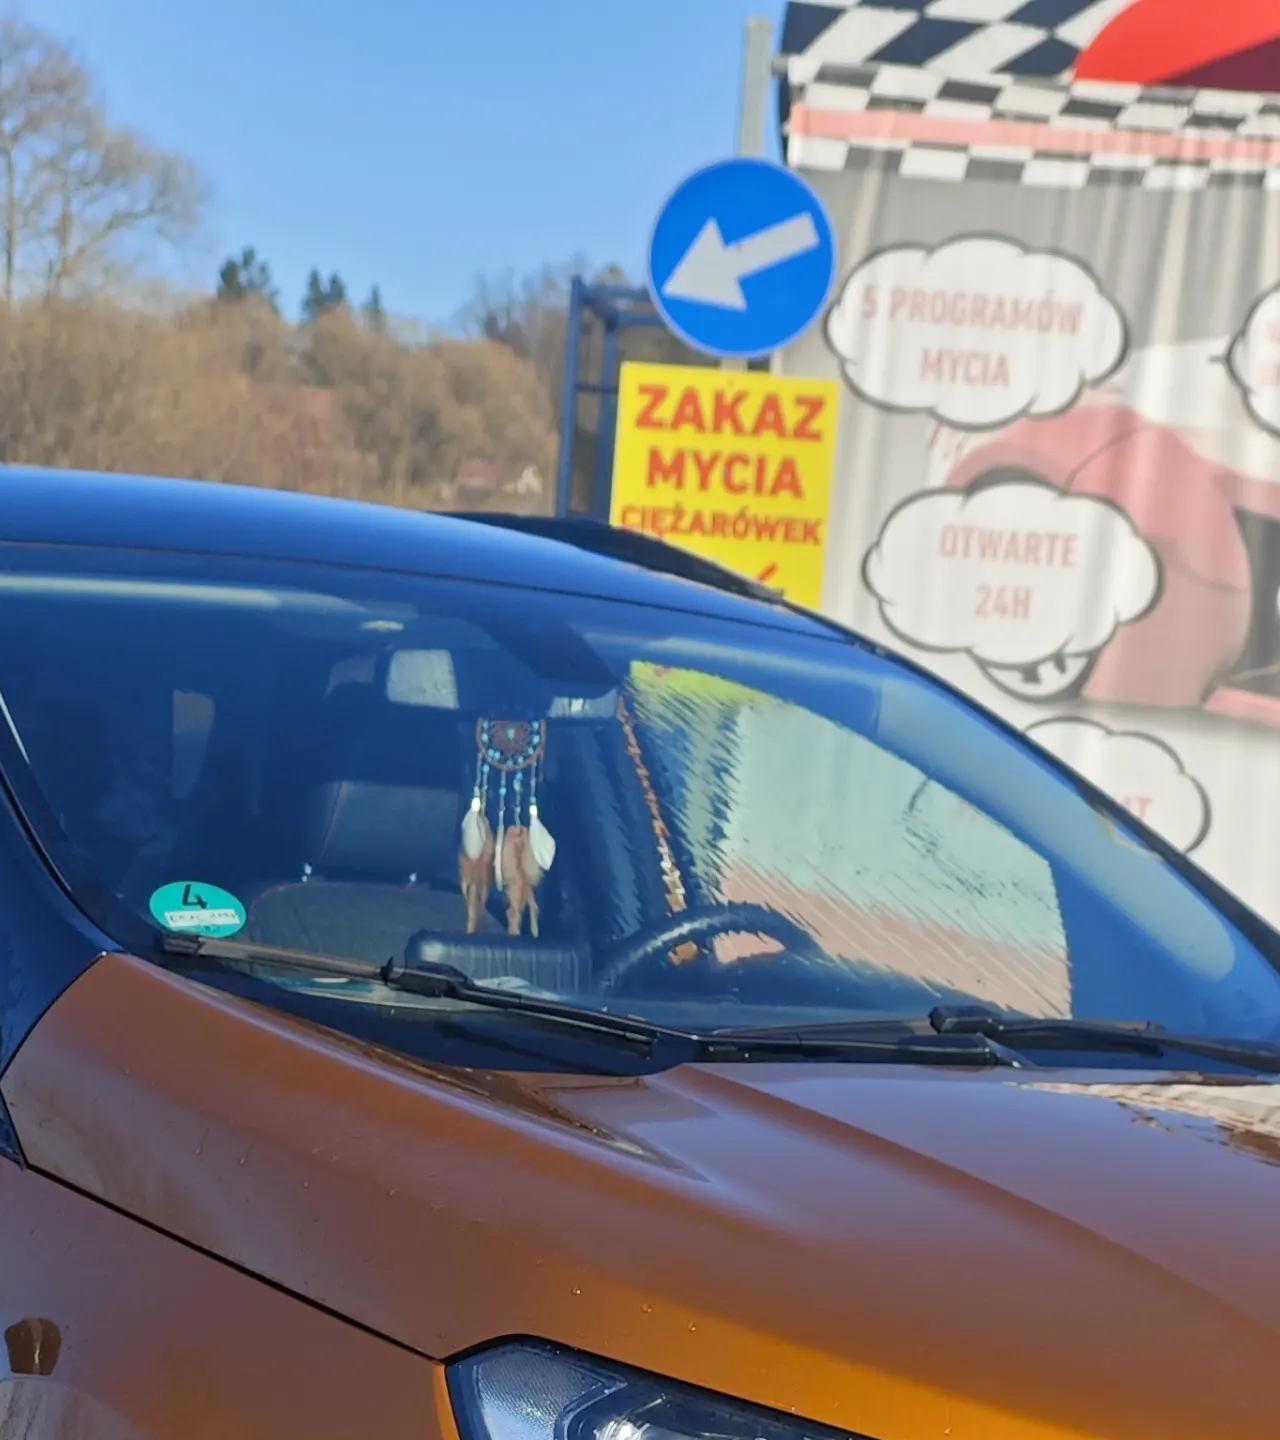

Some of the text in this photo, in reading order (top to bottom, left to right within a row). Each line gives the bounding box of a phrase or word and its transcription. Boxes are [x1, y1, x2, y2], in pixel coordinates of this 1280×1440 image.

[888, 286, 1083, 335] PROGRAMÓW
[920, 347, 1010, 387] MYCIA
[635, 383, 826, 441] ZAKAZ
[647, 446, 804, 499] MYCIA
[620, 502, 824, 546] CIĘŻARÓWEK
[939, 523, 1078, 567] OTWARTE
[975, 583, 1032, 620] 24H
